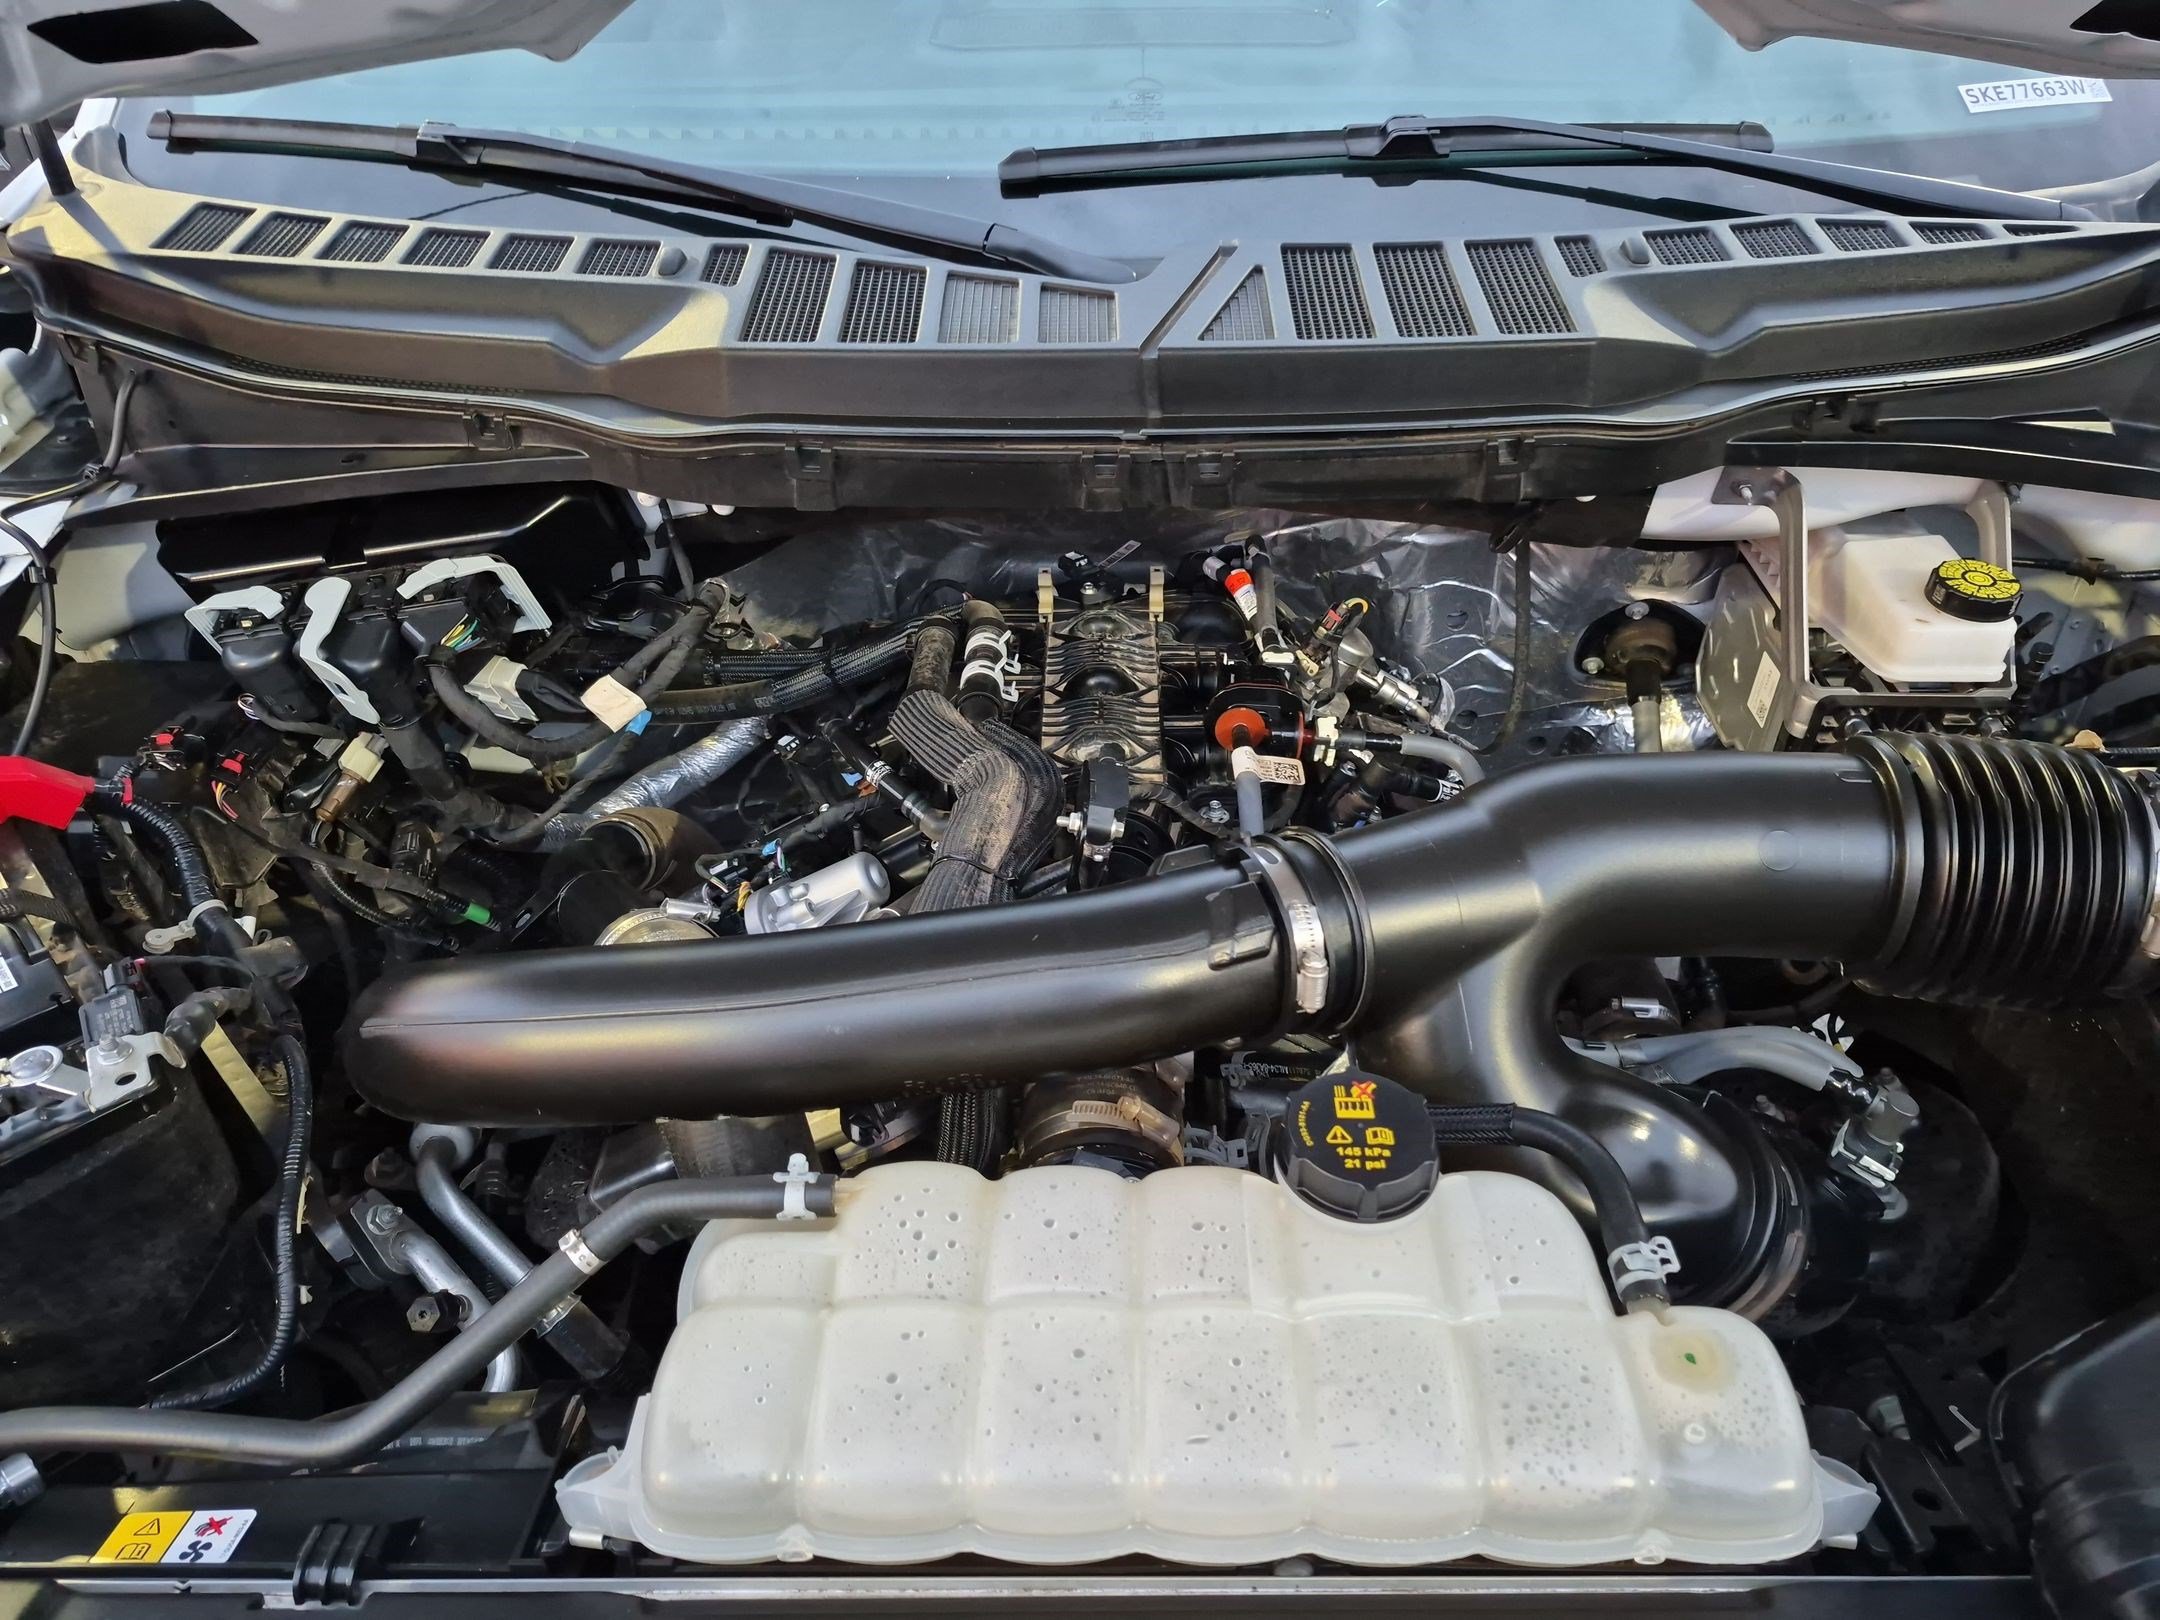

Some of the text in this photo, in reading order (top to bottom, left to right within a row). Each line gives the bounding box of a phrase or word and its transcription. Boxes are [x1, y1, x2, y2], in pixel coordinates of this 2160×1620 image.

[1965, 79, 2087, 104] SKE77663W
[1335, 1146, 1391, 1158] 145 kPa
[1344, 1158, 1387, 1171] 21 psi
